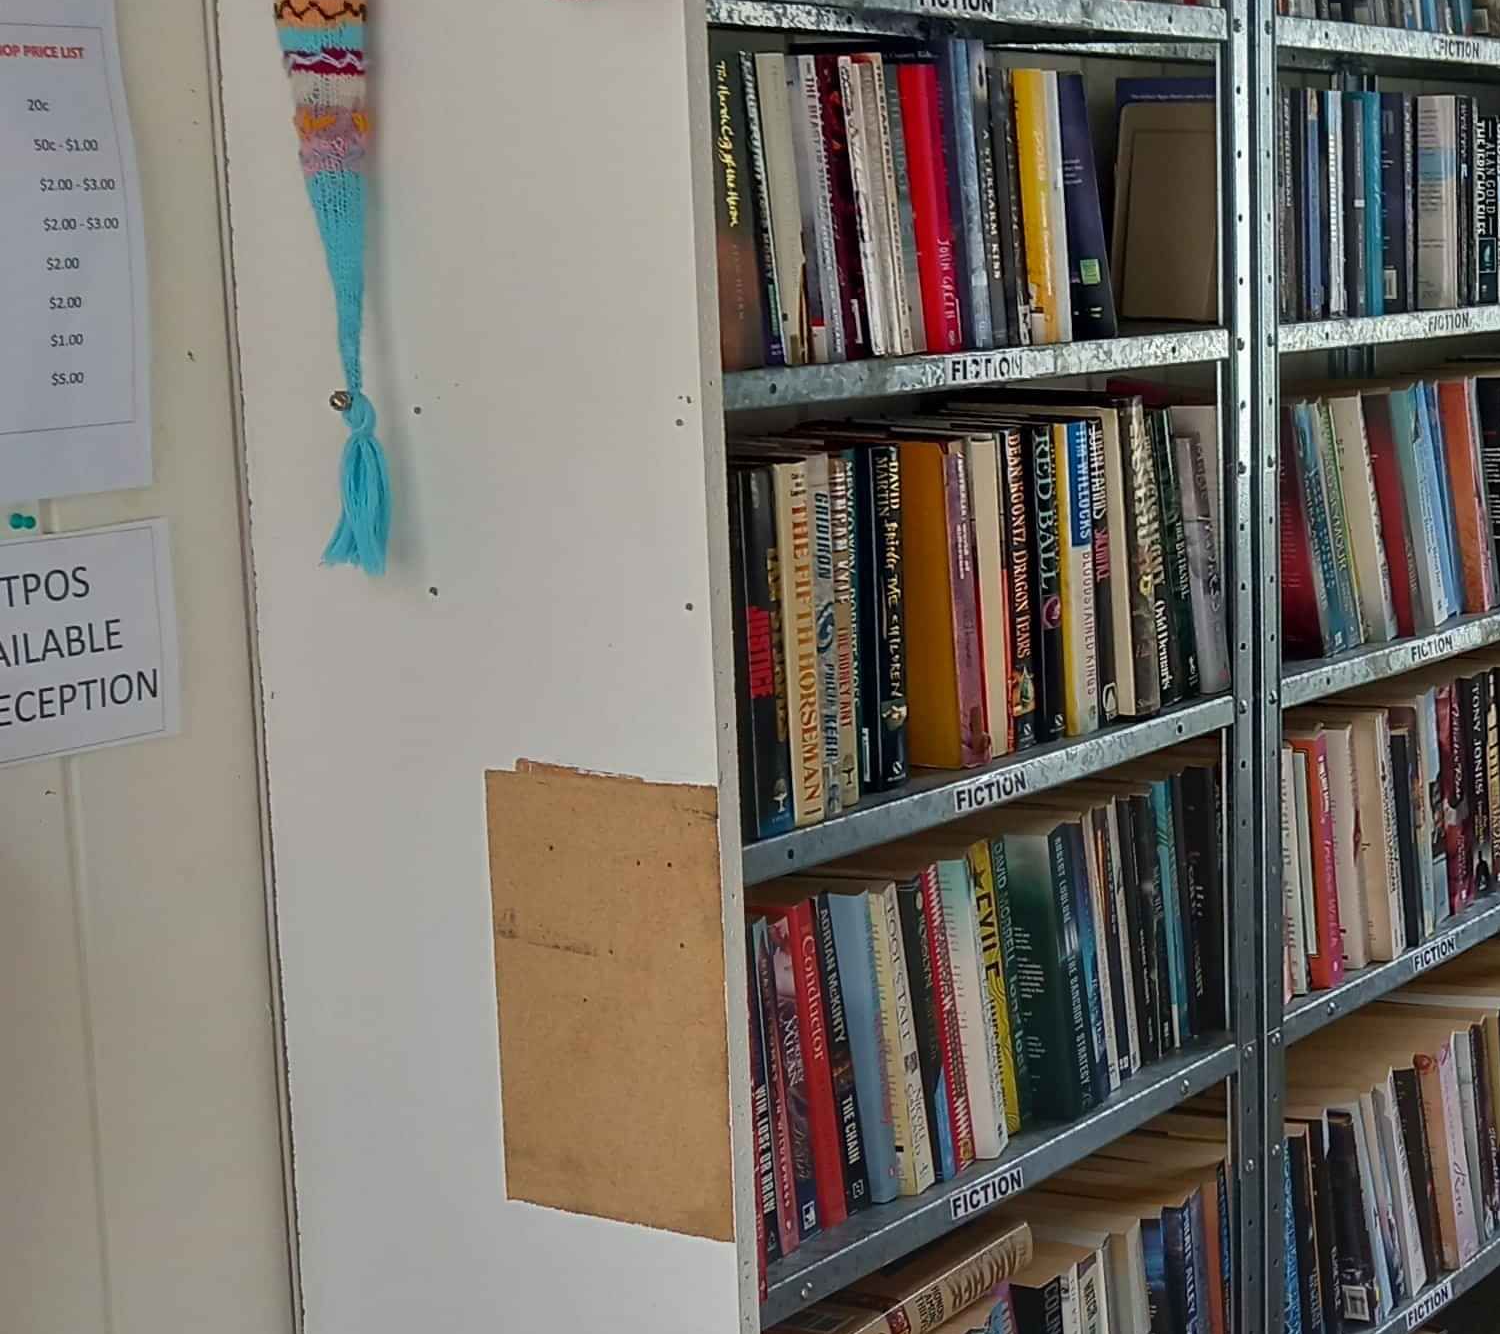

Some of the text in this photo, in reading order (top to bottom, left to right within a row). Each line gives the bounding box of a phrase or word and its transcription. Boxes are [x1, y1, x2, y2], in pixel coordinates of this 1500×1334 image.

[23, 45, 57, 58] PRICE
[60, 47, 84, 59] LIST
[1439, 39, 1479, 57] FICTION
[27, 99, 49, 111] 20c
[34, 138, 98, 152] 50c $1.00
[40, 178, 115, 191] $2.00 $3.00
[1486, 142, 1496, 214] ALAN GOLD
[43, 217, 119, 231] $2.00 $3.00
[47, 257, 79, 270] $2.00
[937, 238, 954, 320] JOHN GREEN
[50, 296, 82, 309] $2.00
[1429, 312, 1469, 331] FICTION
[51, 333, 84, 346] $1.00
[52, 372, 84, 385] $5.00
[876, 456, 900, 519] DAVID MARTIN
[1077, 468, 1092, 539] WILLOCKS
[1033, 431, 1058, 590] RED BALL
[816, 492, 834, 583] GRIDIRON
[1007, 433, 1032, 659] DEAN KOONTZ DRAGON TEARS
[790, 505, 823, 802] THE FIFTH HORSEMAN
[1411, 634, 1453, 662] FICTION
[824, 715, 839, 760] KERR
[1471, 683, 1484, 795] TONY JONES
[957, 771, 1027, 810] FICTION
[994, 841, 1008, 887] DAVID
[1054, 836, 1090, 1085] ROBERT LUDLUM THE BANCROFT STRATEGY
[1415, 938, 1455, 970] FICTION
[801, 934, 826, 1062] Conductor
[782, 1016, 799, 1088] MILAN
[819, 908, 862, 1165] ADRIAN McKINTY THE CHAIN
[760, 1153, 773, 1171] OR
[761, 1174, 776, 1214] DRAW
[953, 1170, 1023, 1217] FICTION
[1185, 1266, 1197, 1315] ALLEY
[1408, 1285, 1449, 1327] FICTION
